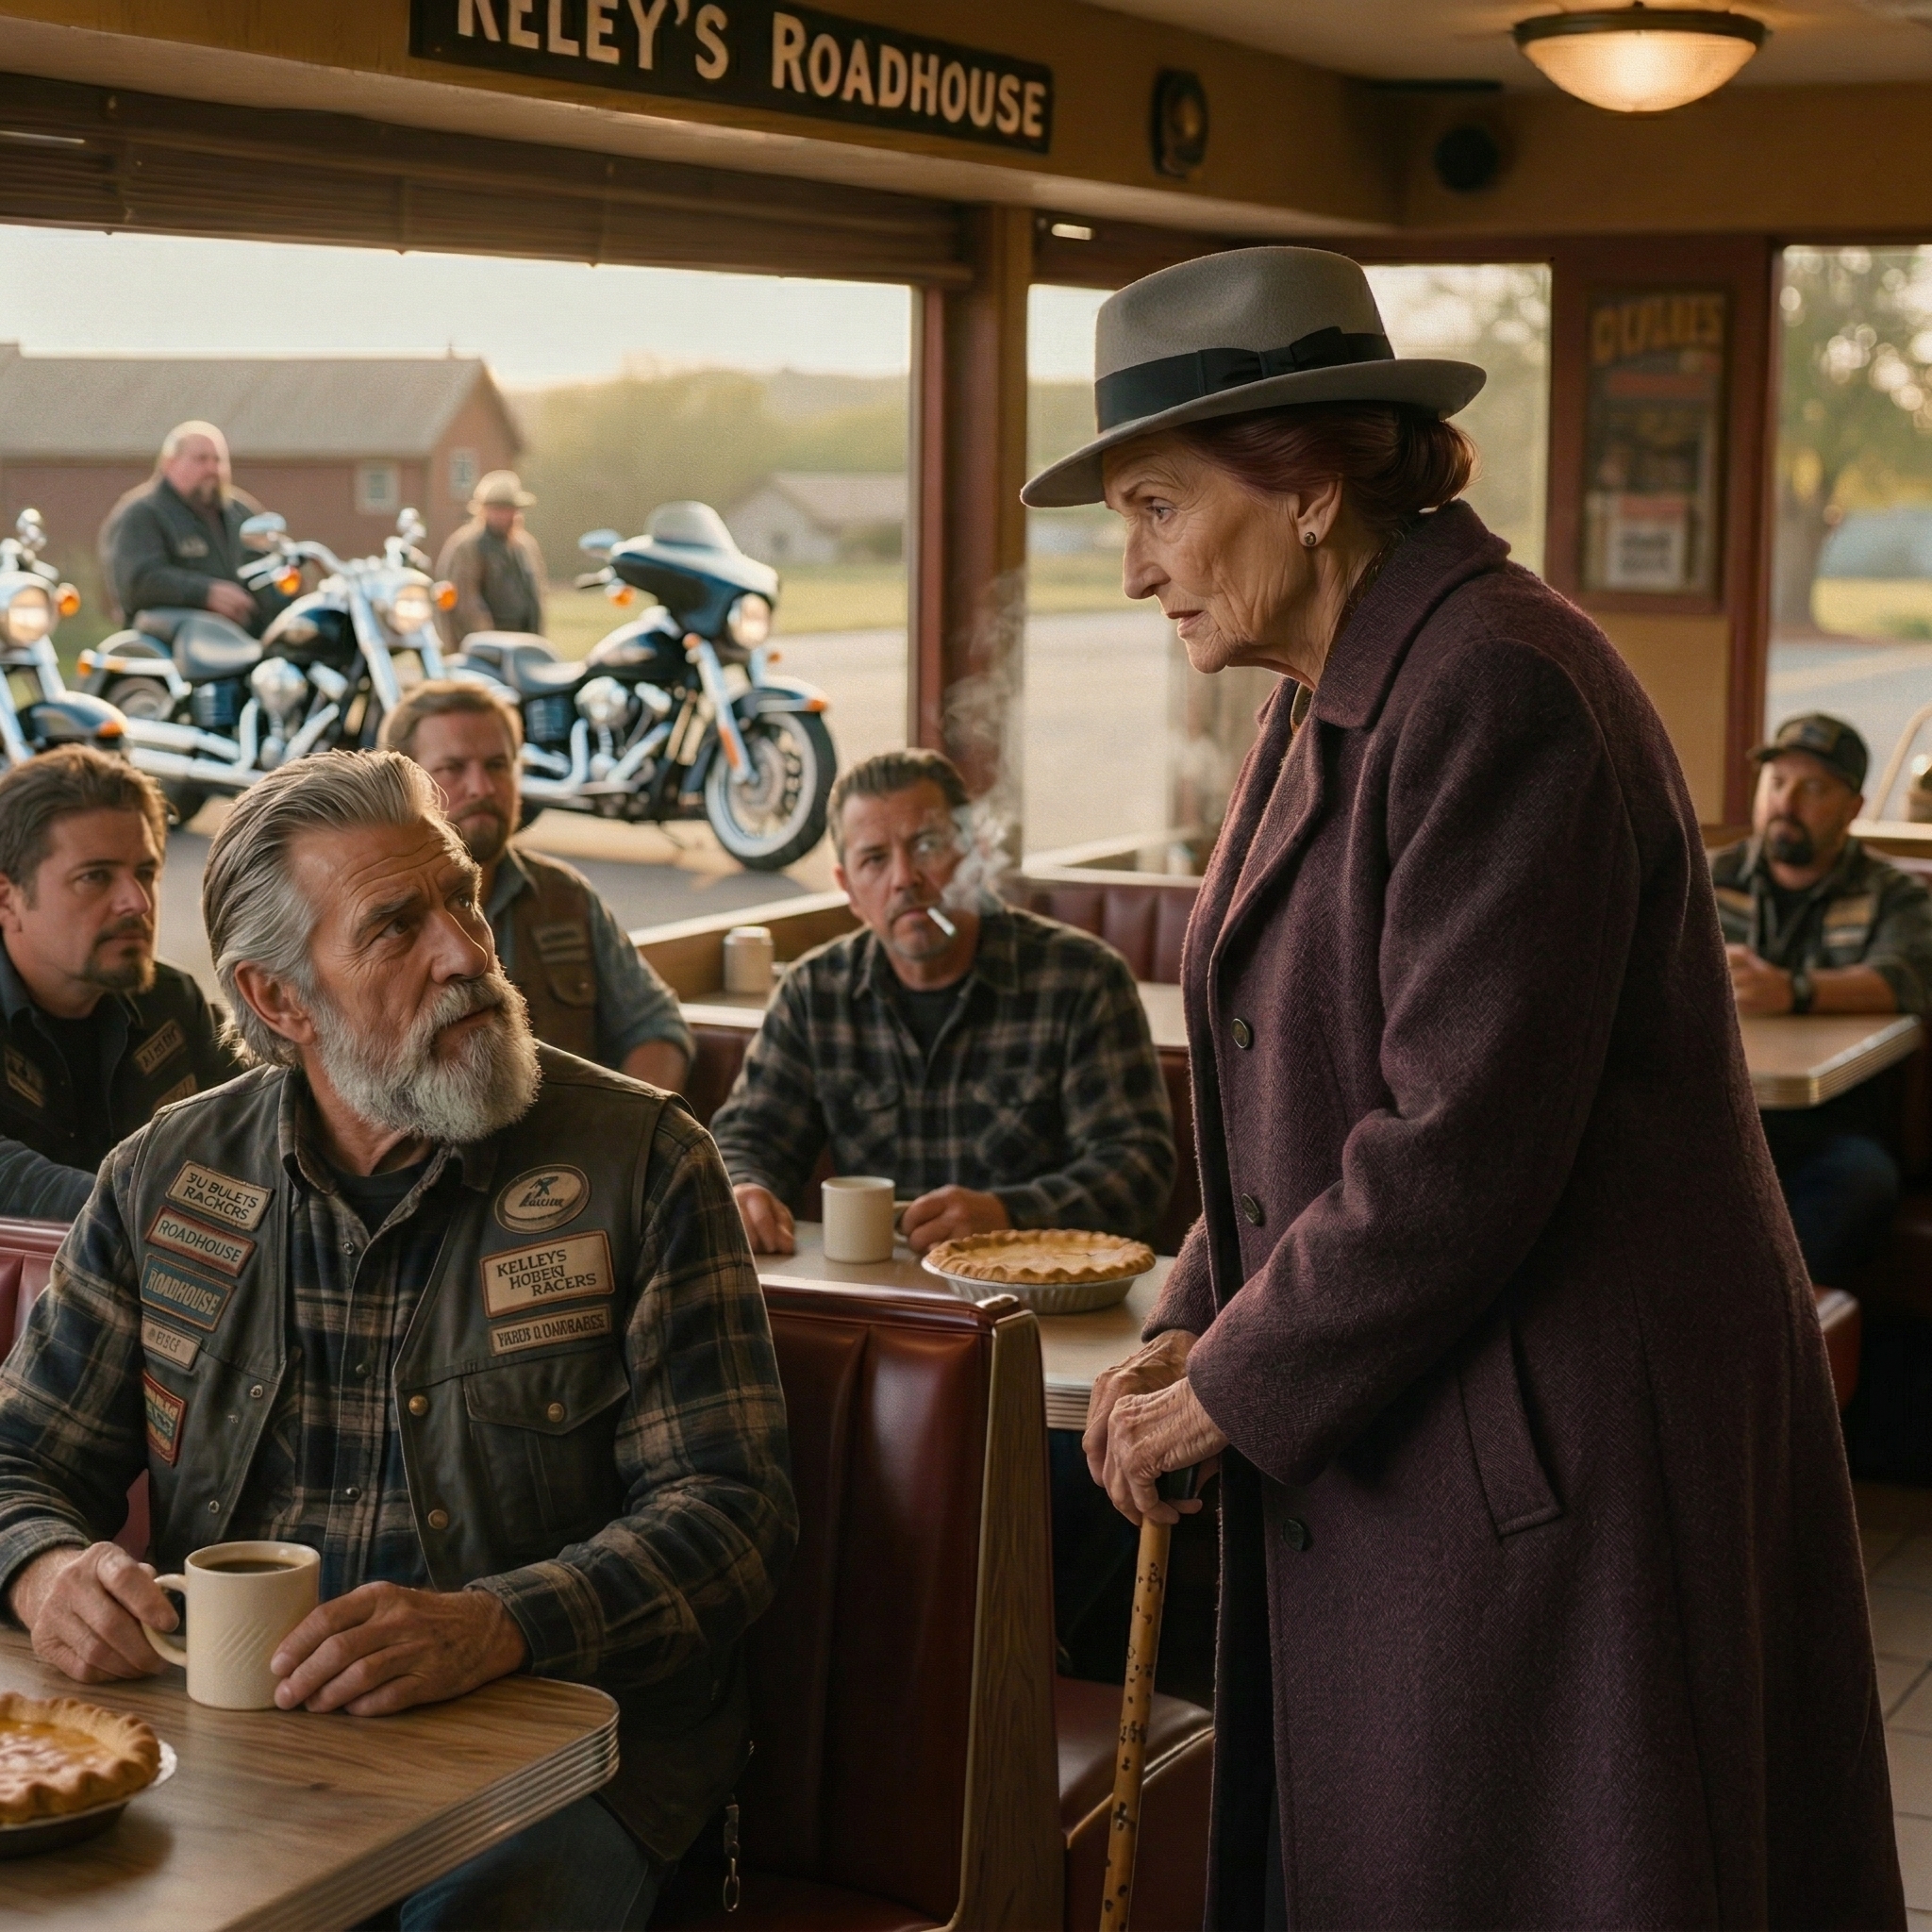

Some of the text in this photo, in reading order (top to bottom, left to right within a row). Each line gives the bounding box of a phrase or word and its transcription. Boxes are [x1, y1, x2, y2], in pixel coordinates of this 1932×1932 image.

[772, 12, 1045, 137] ROADHOUSE
[158, 1220, 242, 1262] ROADHOUSE
[496, 1249, 567, 1277] KELLEYS
[531, 1273, 597, 1297] RACERS
